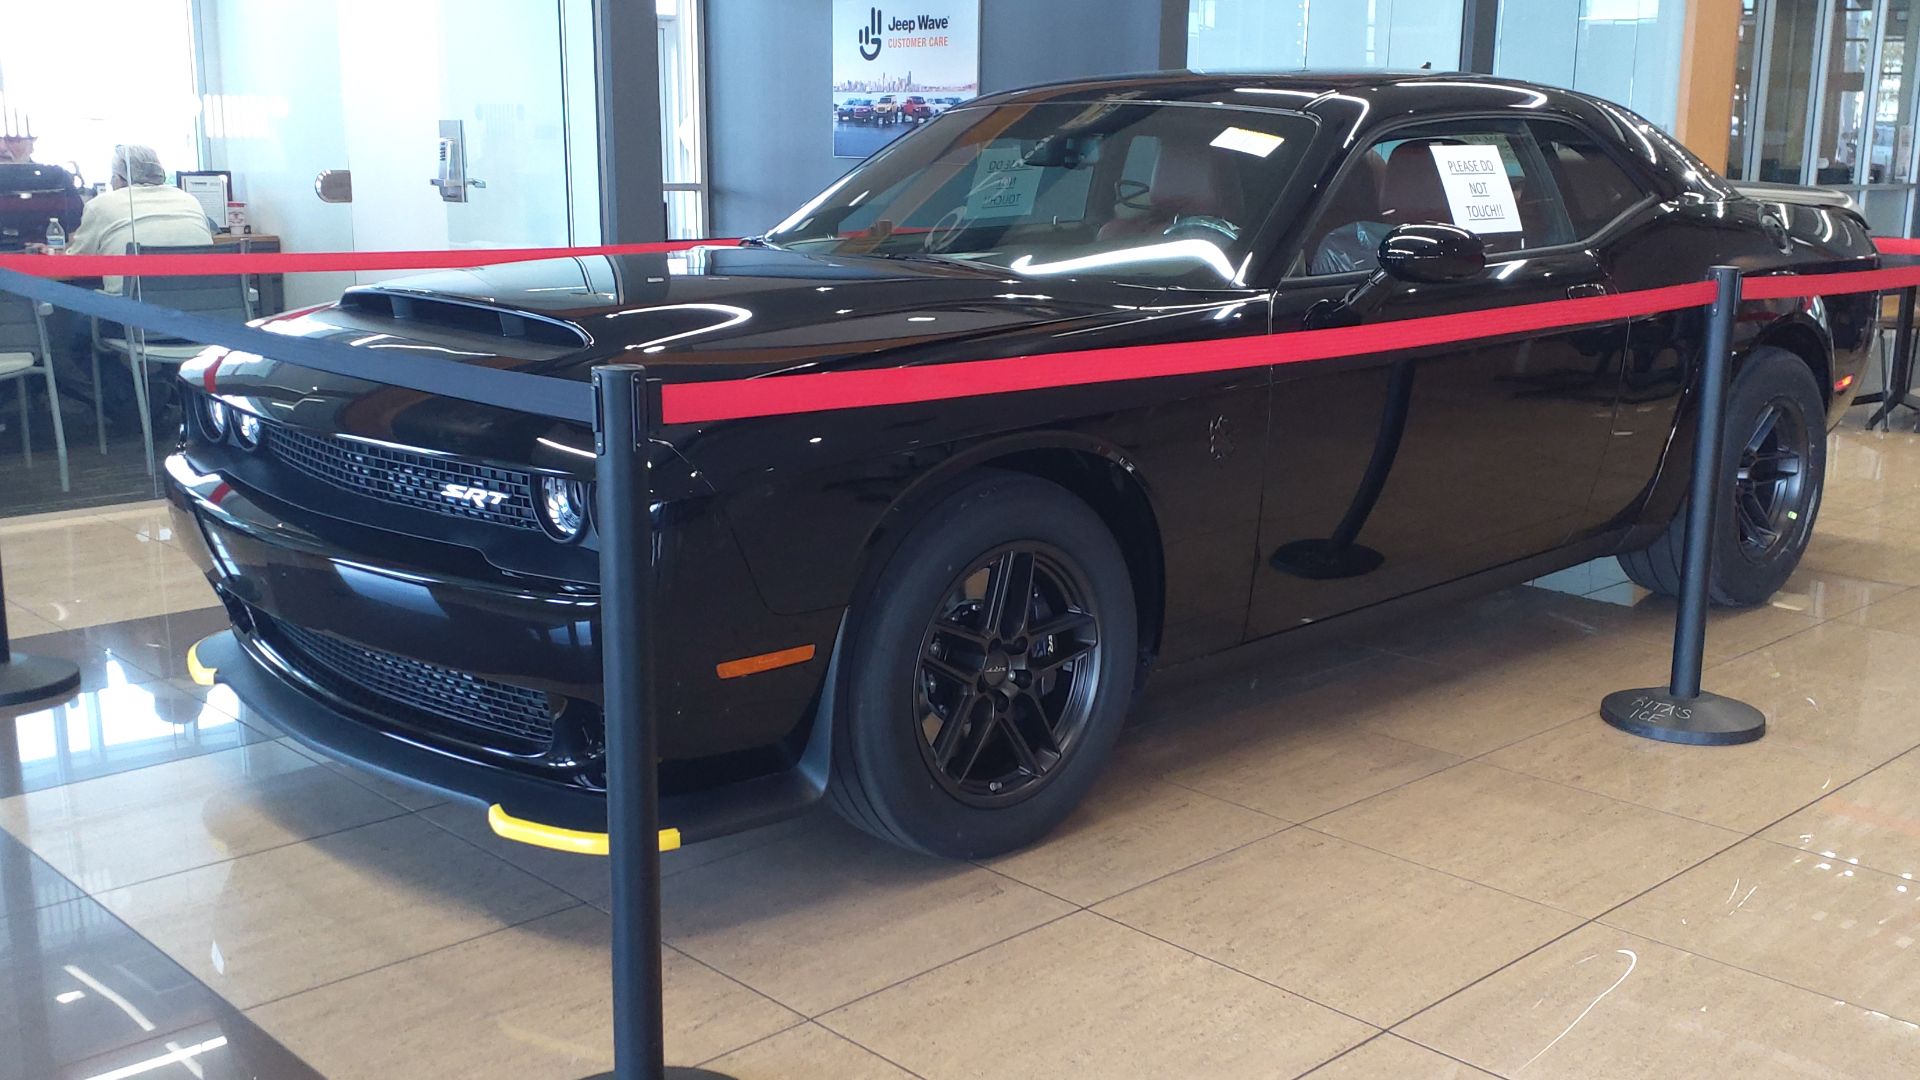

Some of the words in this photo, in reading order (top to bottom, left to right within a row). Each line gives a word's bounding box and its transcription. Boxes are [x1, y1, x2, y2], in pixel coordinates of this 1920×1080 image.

[888, 16, 915, 34] Jeep
[888, 37, 927, 49] CUSTOMER
[929, 36, 948, 47] CARE
[1448, 160, 1480, 172] PLEASE
[1480, 159, 1494, 172] DO
[1468, 182, 1487, 195] NOT
[1465, 205, 1504, 218] TOUCH!!
[440, 483, 509, 507] SRT
[1629, 709, 1666, 723] ICE
